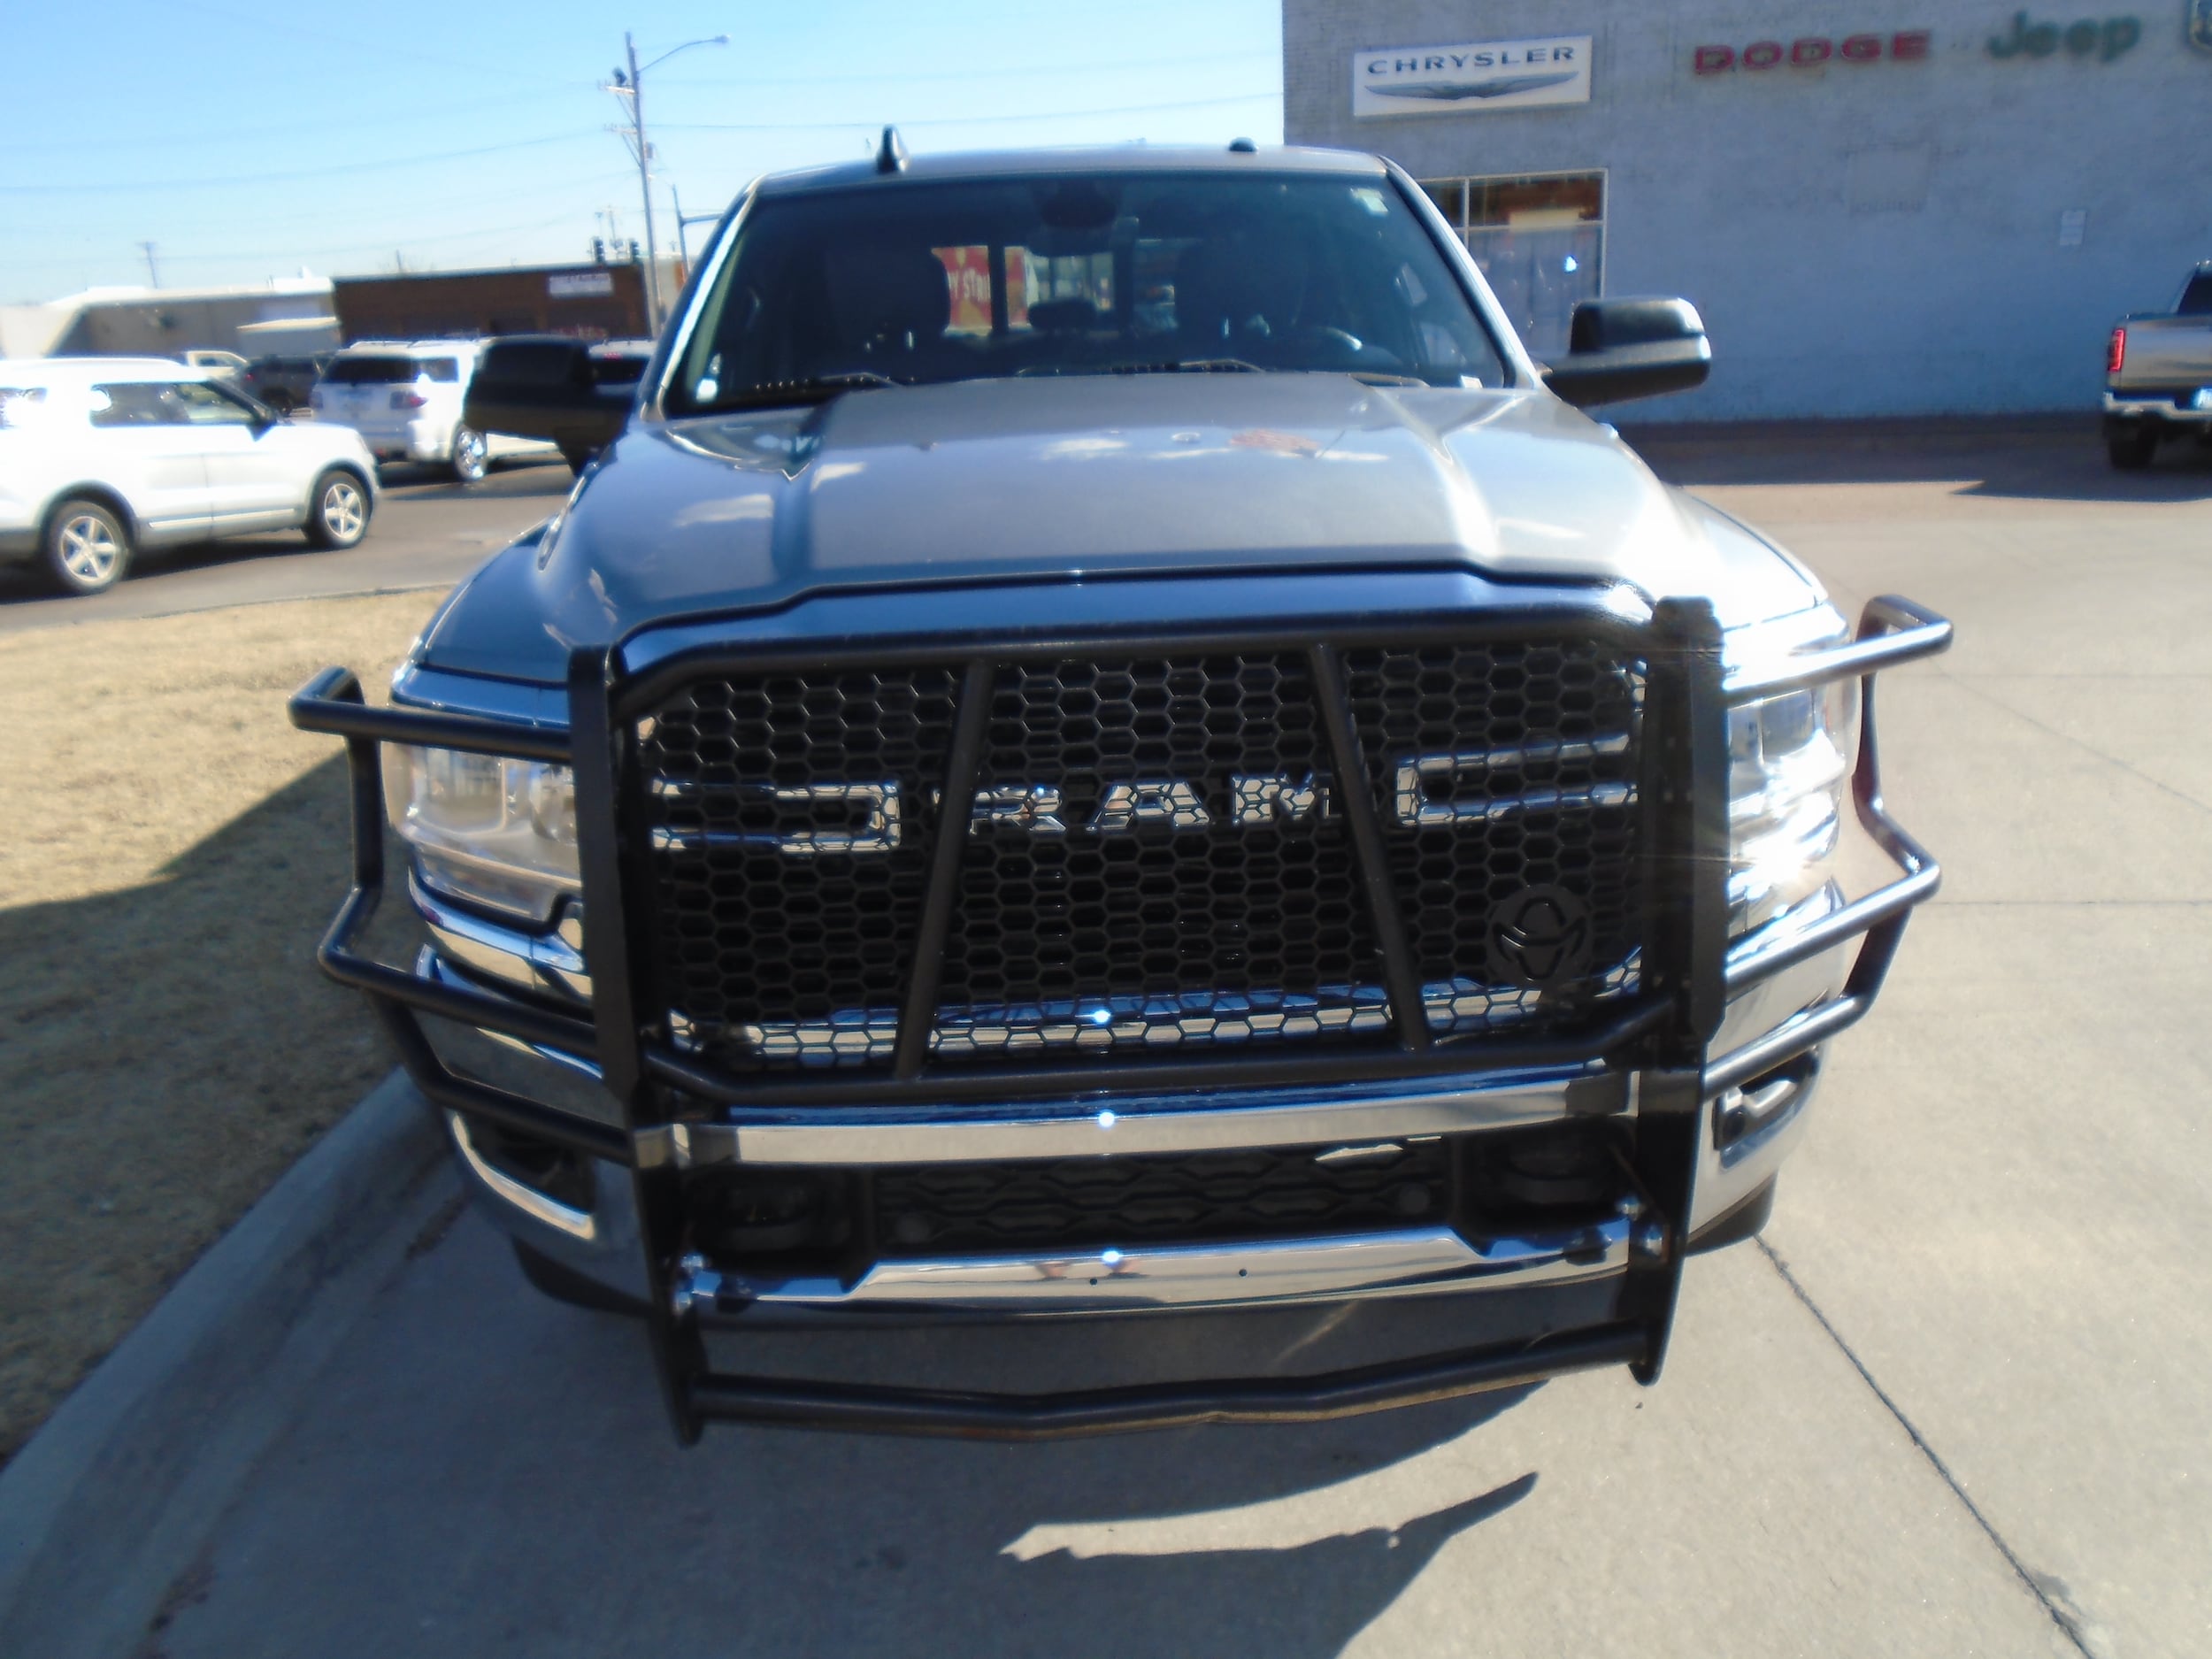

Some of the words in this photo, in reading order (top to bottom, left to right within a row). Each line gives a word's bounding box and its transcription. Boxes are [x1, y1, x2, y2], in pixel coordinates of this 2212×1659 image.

[1694, 30, 1931, 74] DODGE
[1987, 10, 2141, 62] Jeep
[1367, 47, 1575, 74] CHRYSLER
[938, 773, 1343, 835] RAM
